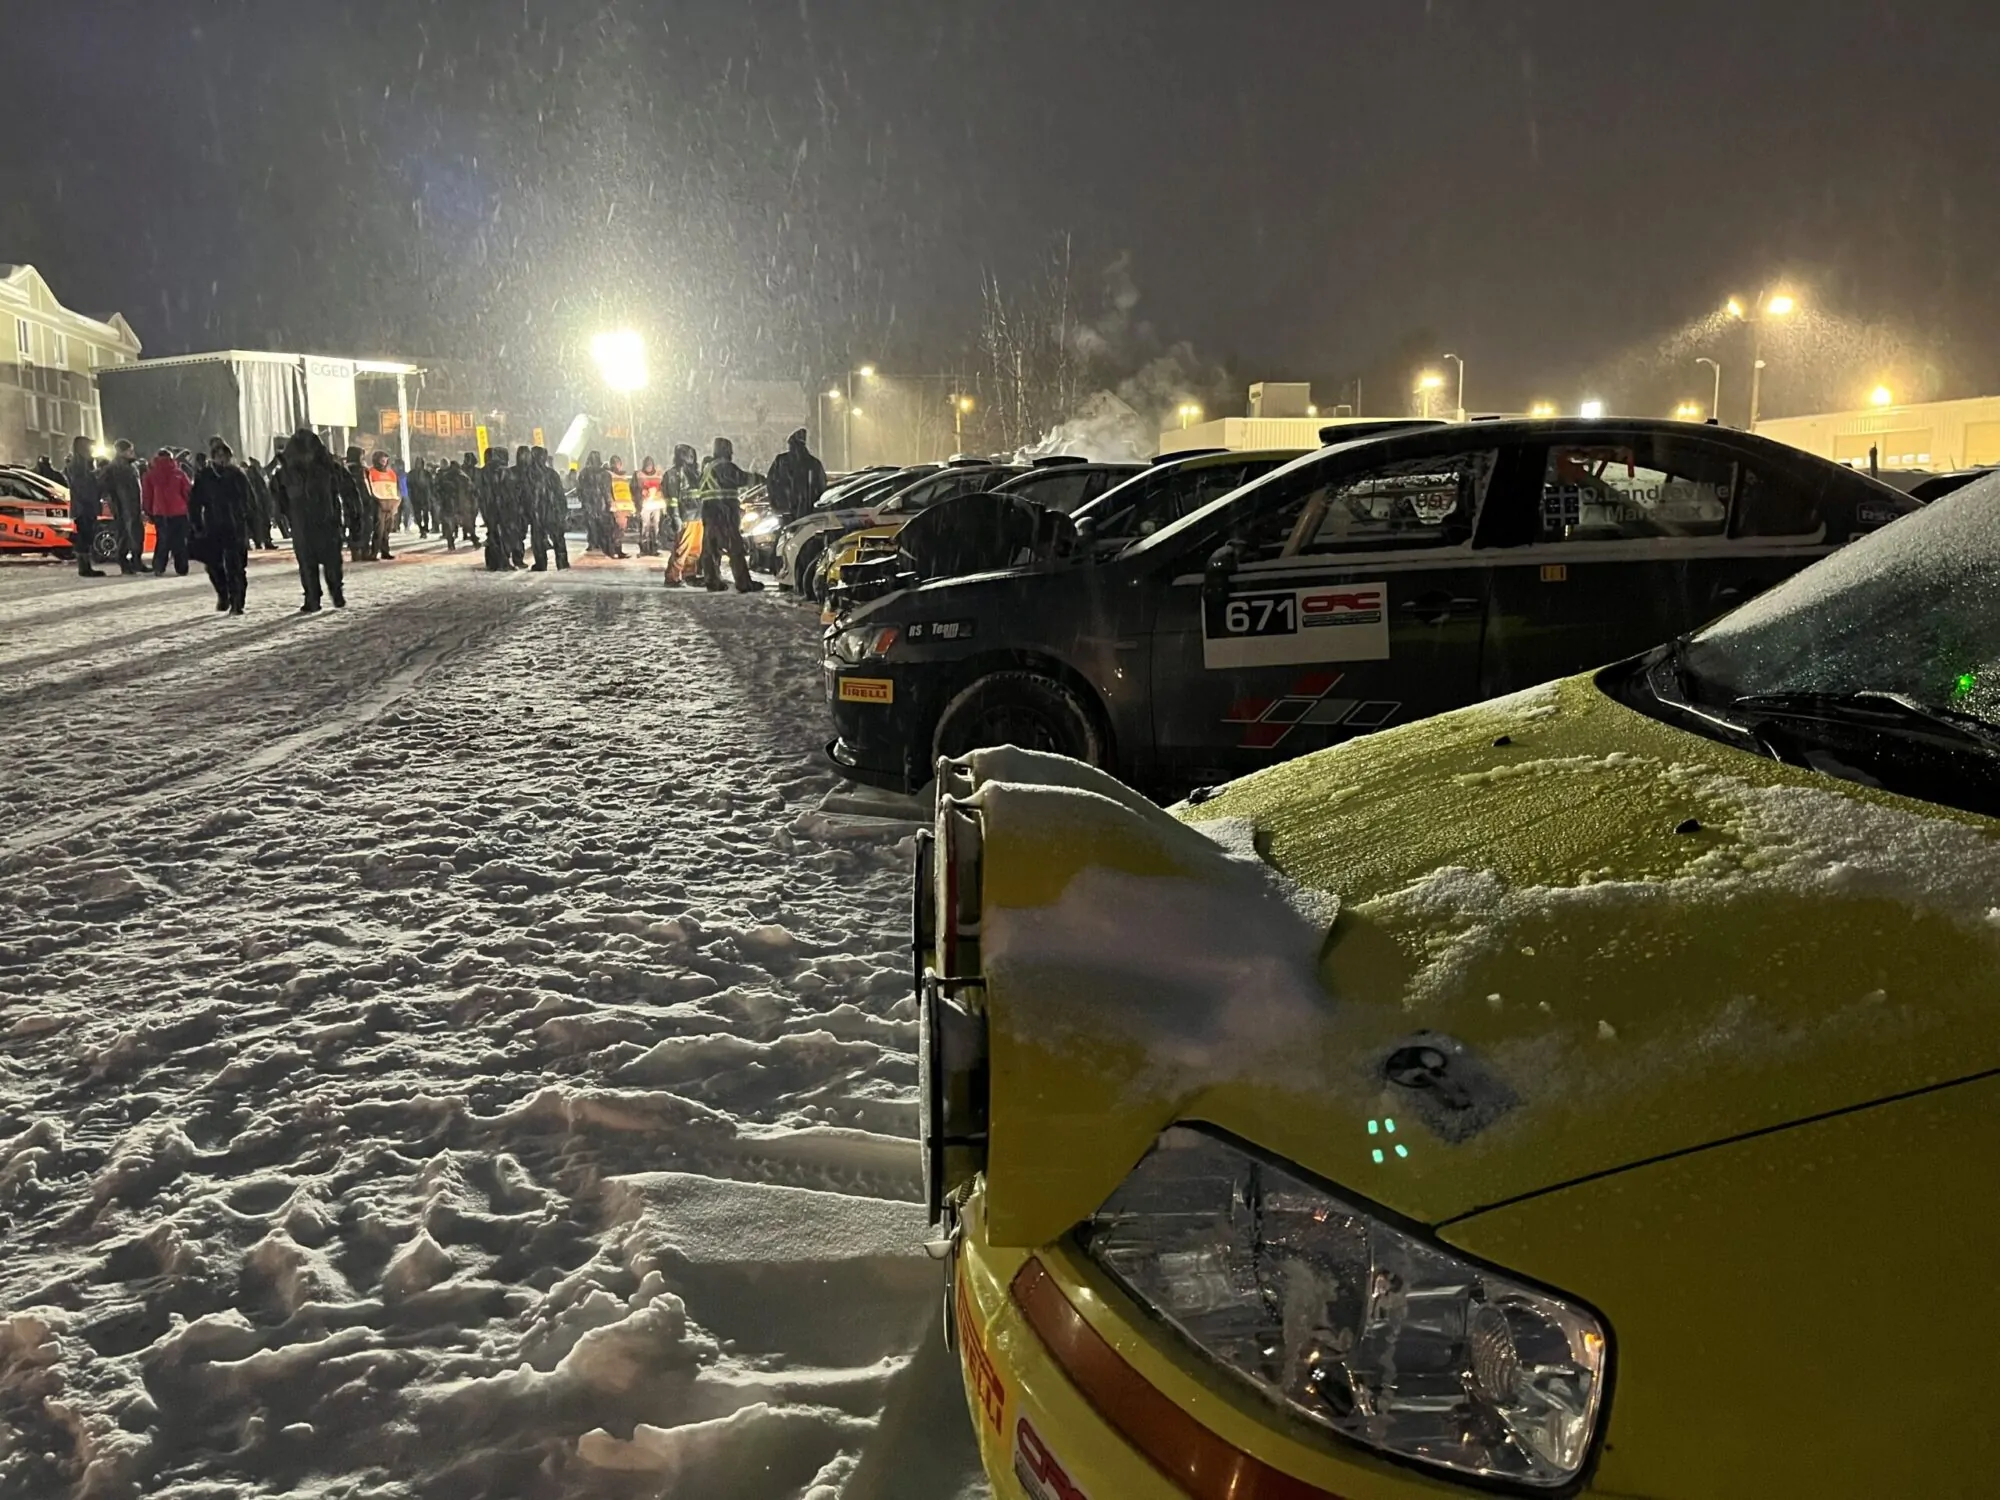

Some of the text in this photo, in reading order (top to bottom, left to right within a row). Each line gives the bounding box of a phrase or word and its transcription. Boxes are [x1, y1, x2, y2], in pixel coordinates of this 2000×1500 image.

[14, 523, 45, 539] Lab
[1225, 598, 1295, 633] 671
[843, 681, 887, 699] PIRELLI
